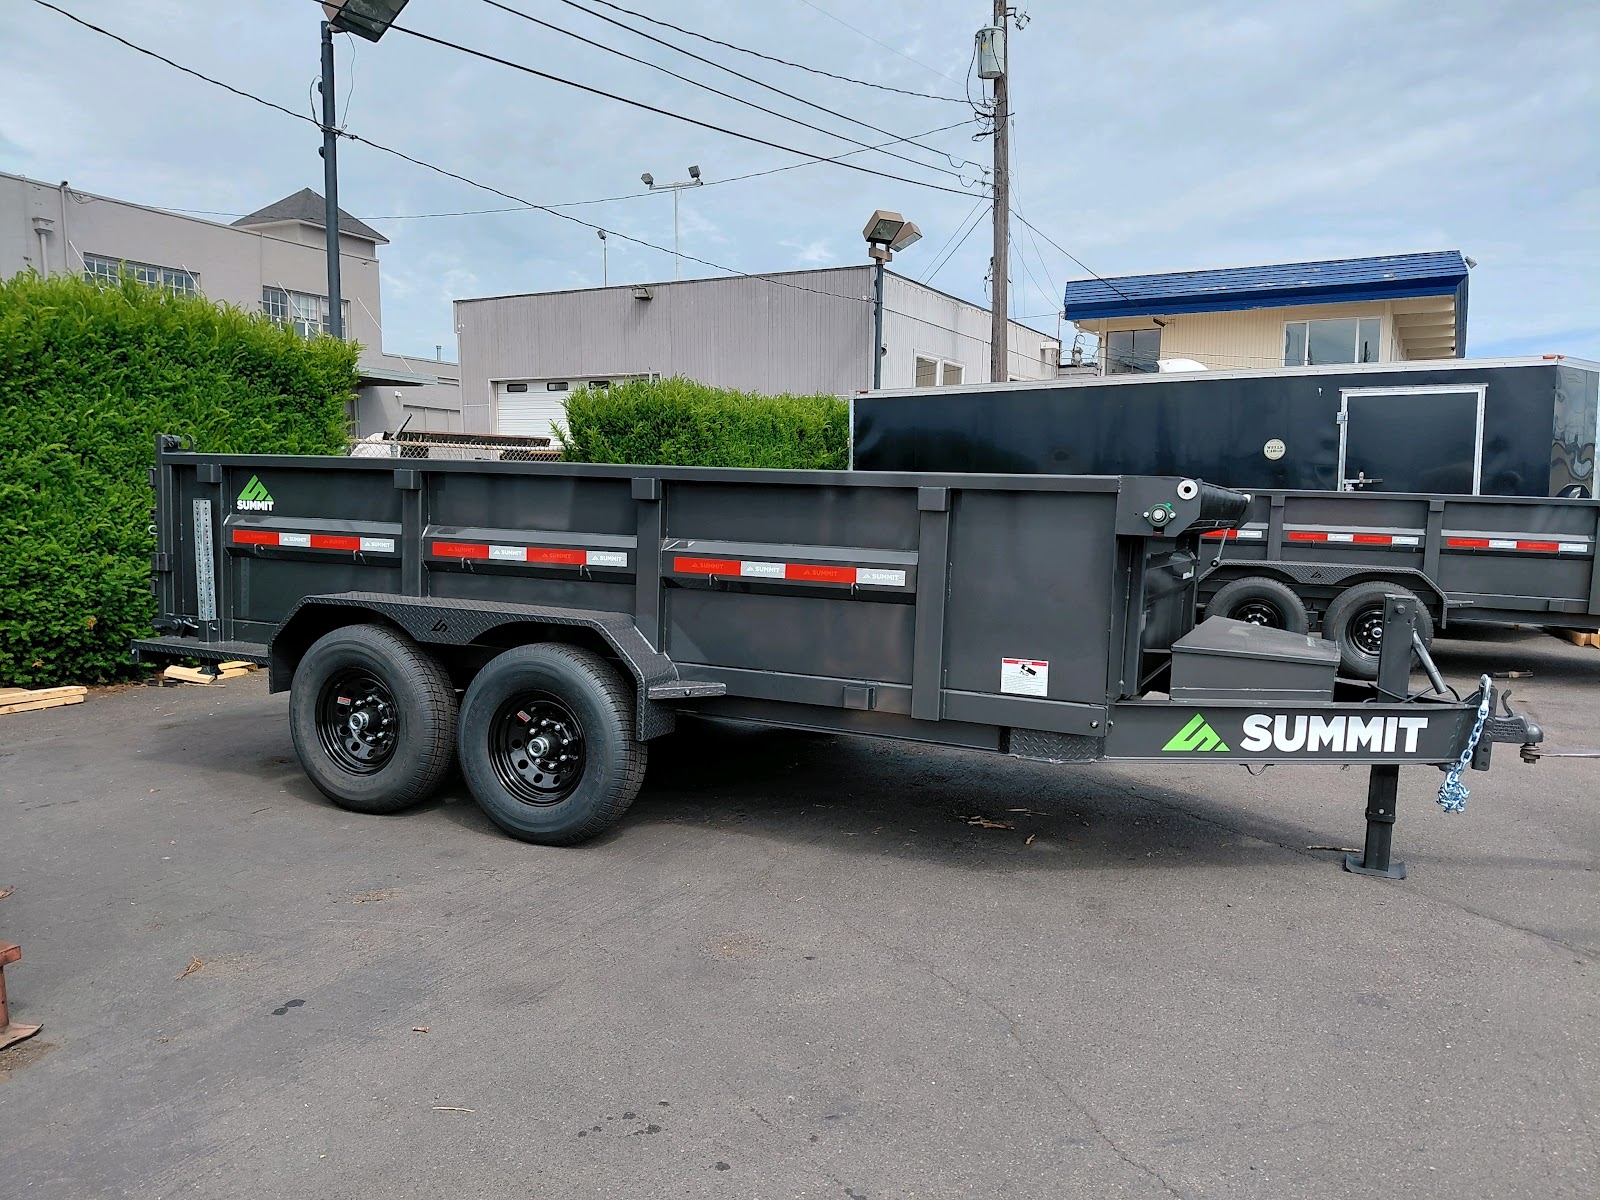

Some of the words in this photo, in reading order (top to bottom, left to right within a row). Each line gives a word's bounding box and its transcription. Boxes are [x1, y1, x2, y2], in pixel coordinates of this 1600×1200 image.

[236, 499, 274, 512] SUMMIT
[699, 562, 724, 570] SUMMIT
[871, 573, 899, 581] SUMMIT
[1240, 714, 1428, 752] SUMMIT
